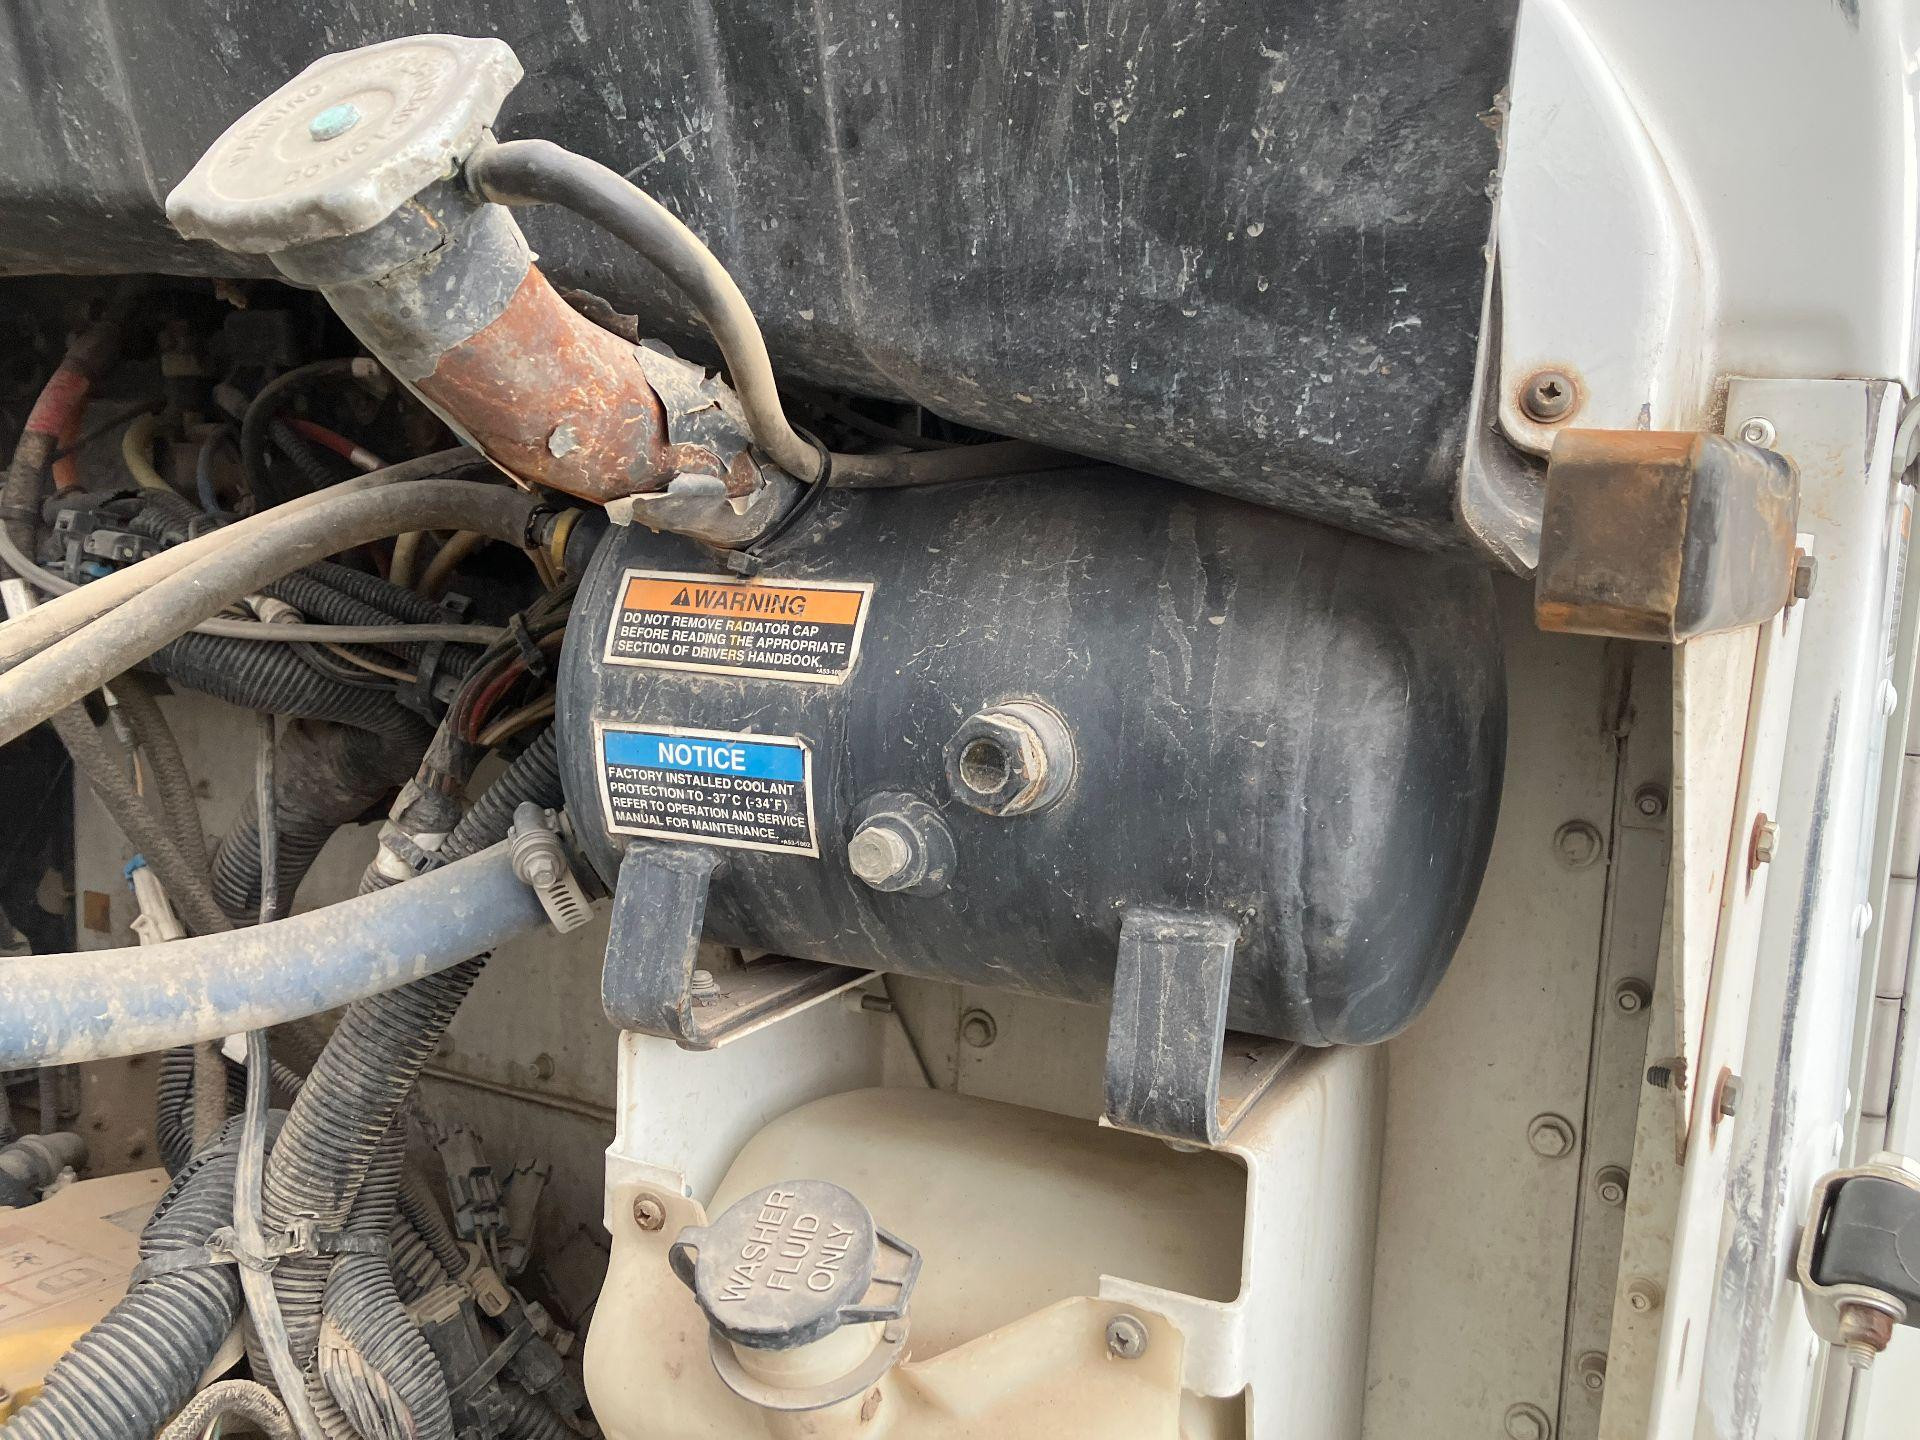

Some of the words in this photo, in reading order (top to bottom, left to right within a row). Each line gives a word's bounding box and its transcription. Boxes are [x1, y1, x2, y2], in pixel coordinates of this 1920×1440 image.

[695, 588, 807, 615] WARNING
[624, 612, 641, 624] DO
[644, 613, 668, 626] NOT
[671, 616, 723, 631] REMOVE
[726, 620, 789, 636] RADIATOR
[792, 625, 819, 638] CAP
[617, 640, 669, 655] SECTION
[672, 644, 689, 656] OF
[691, 646, 745, 662] DRIVERS
[747, 650, 823, 669] HANDBOOK.
[621, 626, 669, 640] BEFORE
[672, 630, 726, 646] READING
[729, 634, 753, 648] THE
[756, 637, 845, 655] APPROPRIATE
[658, 742, 747, 771] NOTICE
[608, 767, 664, 782] FACTORY
[666, 772, 731, 789] INSTALLED
[733, 779, 795, 797] COOLANT
[610, 781, 685, 800] PROTECTION
[687, 789, 704, 802] TO
[612, 797, 648, 811] REFER
[649, 800, 665, 812] TO
[666, 803, 730, 820] OPERATION
[731, 809, 755, 823] AND
[756, 812, 806, 828] SERVICE
[615, 811, 664, 826] MANUAL
[666, 816, 690, 829] FOR
[692, 819, 780, 840] MAINTENANCE.
[718, 1189, 796, 1302] WASHER
[766, 1213, 821, 1292] FLUID
[807, 1222, 854, 1292] ONLY
